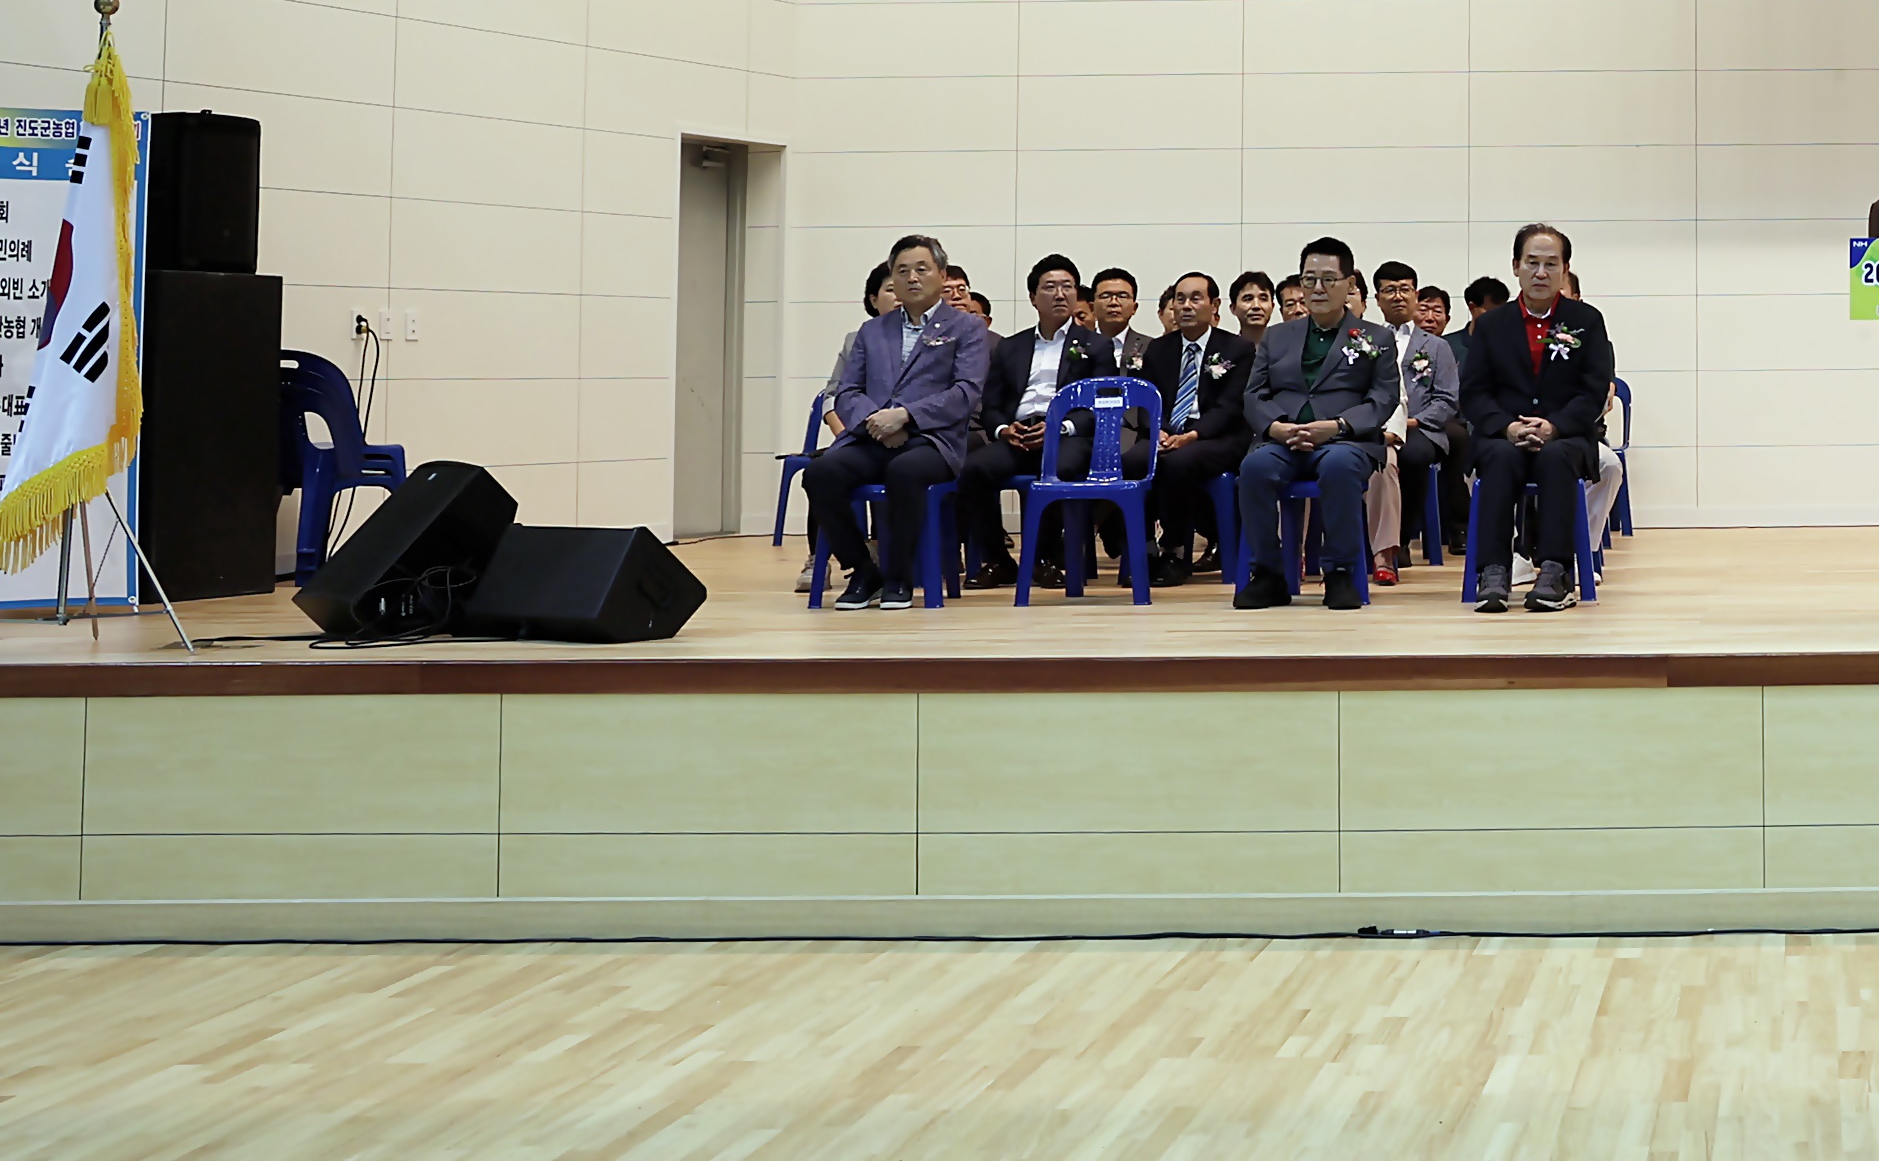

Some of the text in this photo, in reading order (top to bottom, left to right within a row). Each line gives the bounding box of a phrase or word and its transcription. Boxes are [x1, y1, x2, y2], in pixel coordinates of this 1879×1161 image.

[16, 119, 75, 138] 진도군농협
[12, 152, 38, 176] 식
[0, 316, 26, 339] 농협
